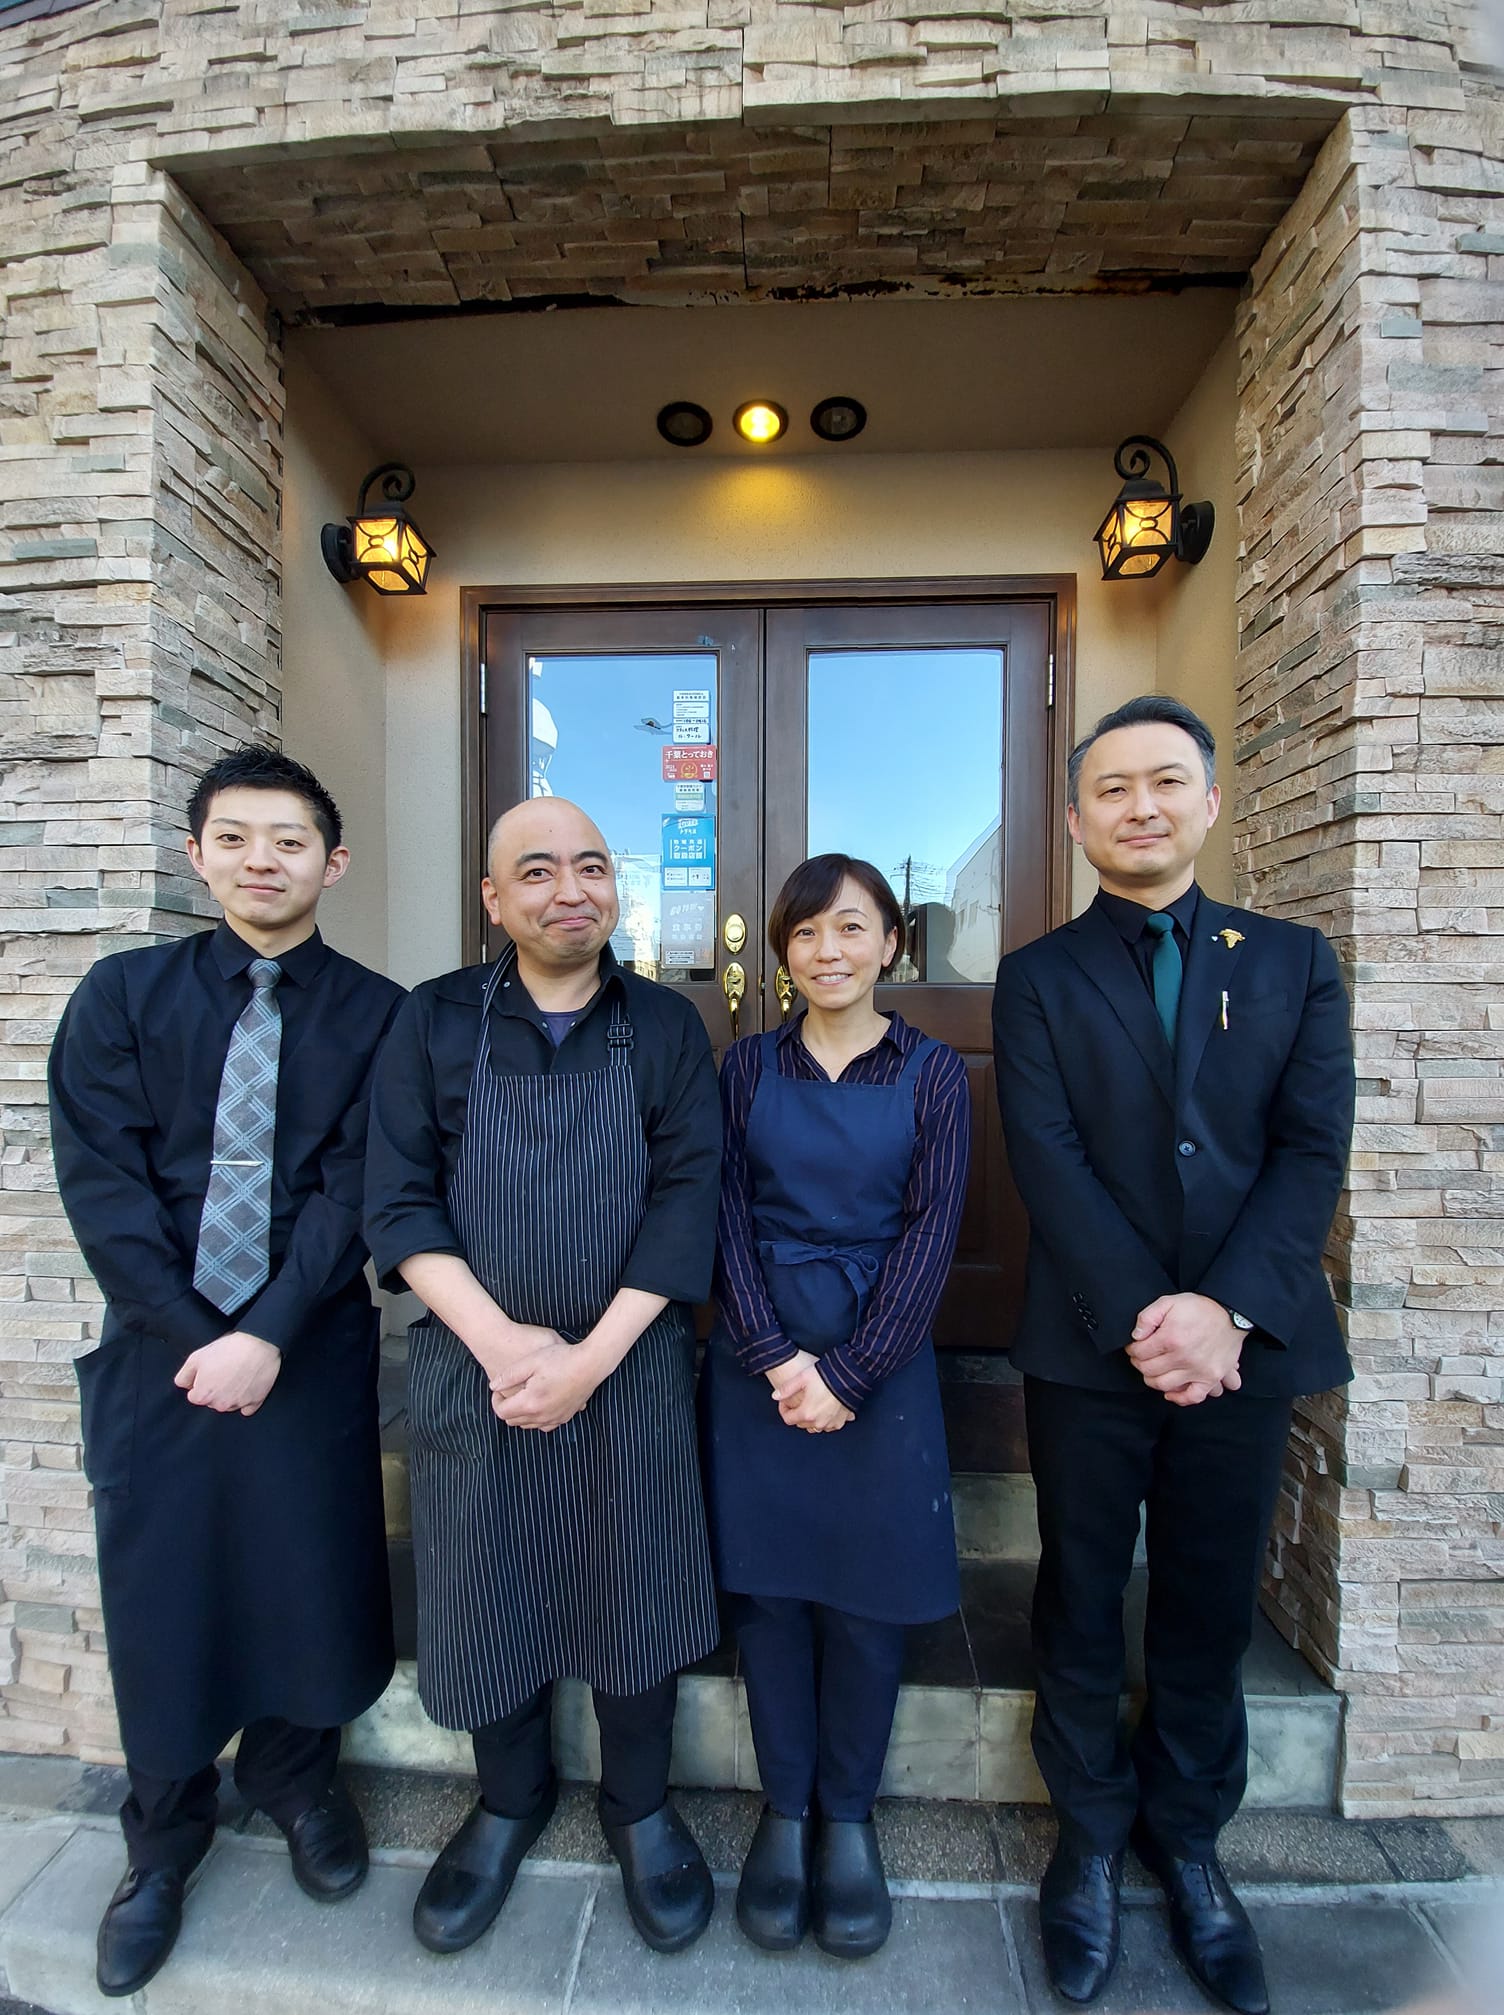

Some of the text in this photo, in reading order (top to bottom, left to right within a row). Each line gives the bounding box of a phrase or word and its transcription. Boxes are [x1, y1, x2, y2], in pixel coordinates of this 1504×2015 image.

[665, 750, 714, 760] 千葉とっておき
